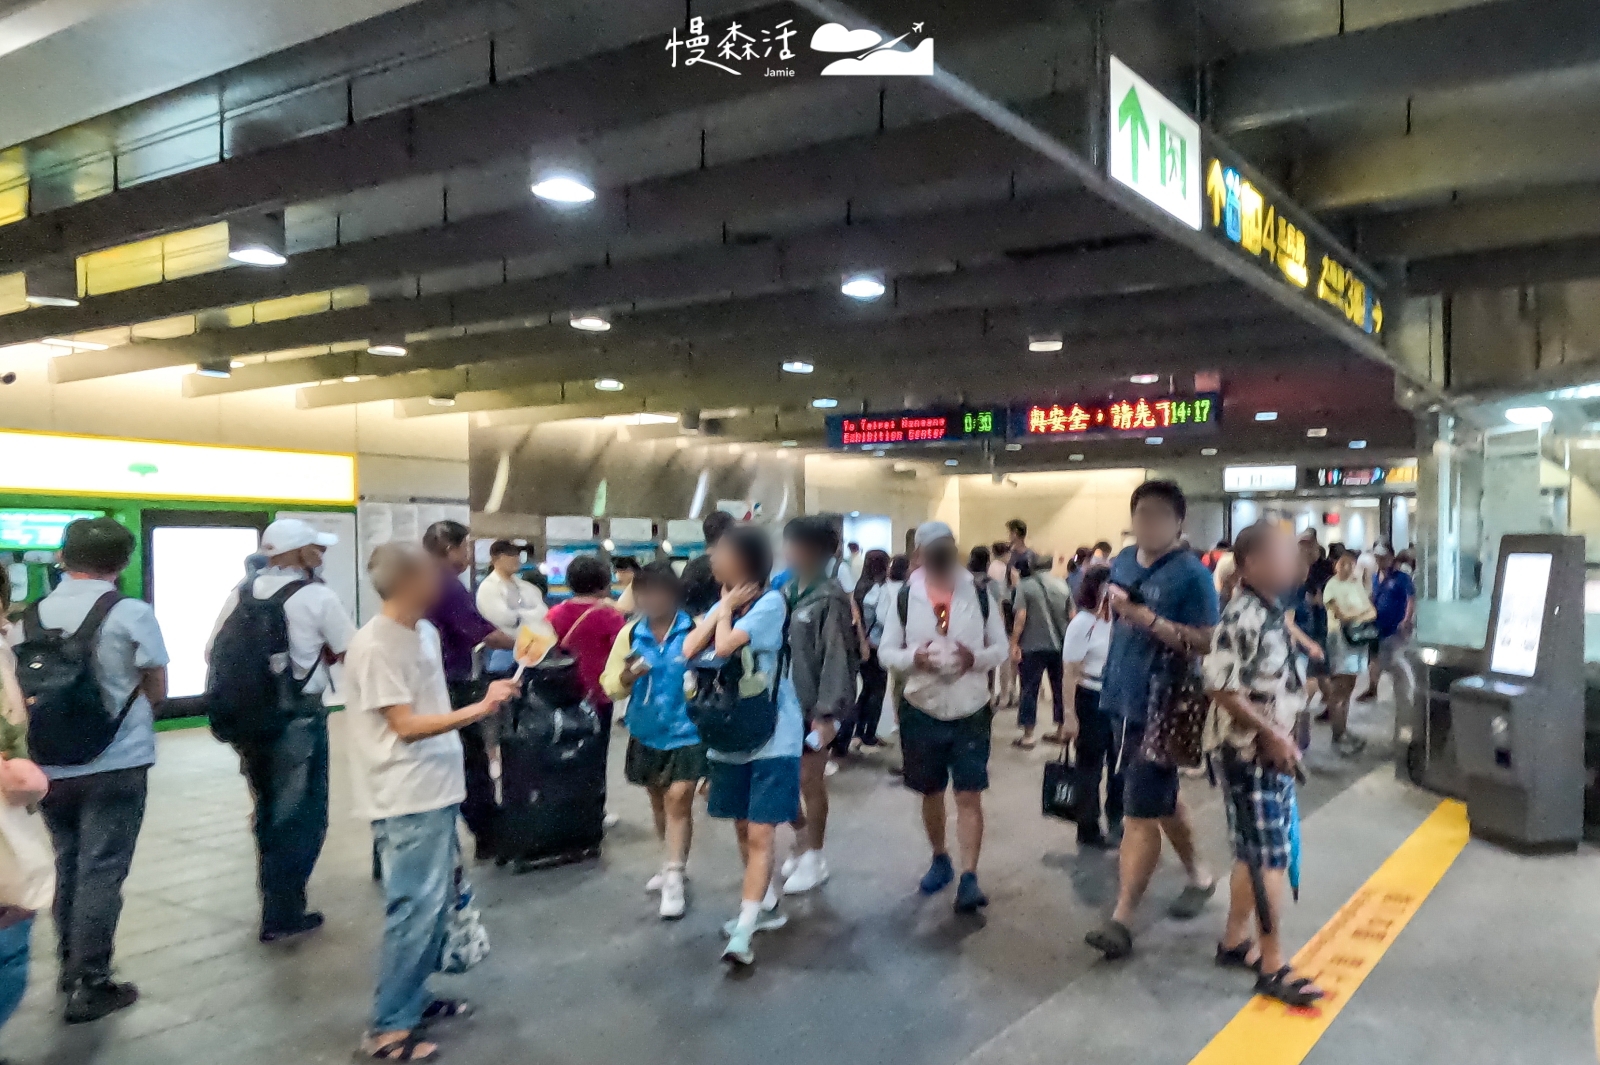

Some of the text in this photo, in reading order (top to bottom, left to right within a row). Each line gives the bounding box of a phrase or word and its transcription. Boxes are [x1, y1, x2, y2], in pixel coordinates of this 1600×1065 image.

[1170, 399, 1210, 424] 14:17
[843, 419, 855, 431] To
[860, 418, 896, 430] Taipei
[964, 412, 992, 433] 0:30
[843, 428, 946, 444] Exhibition Center
